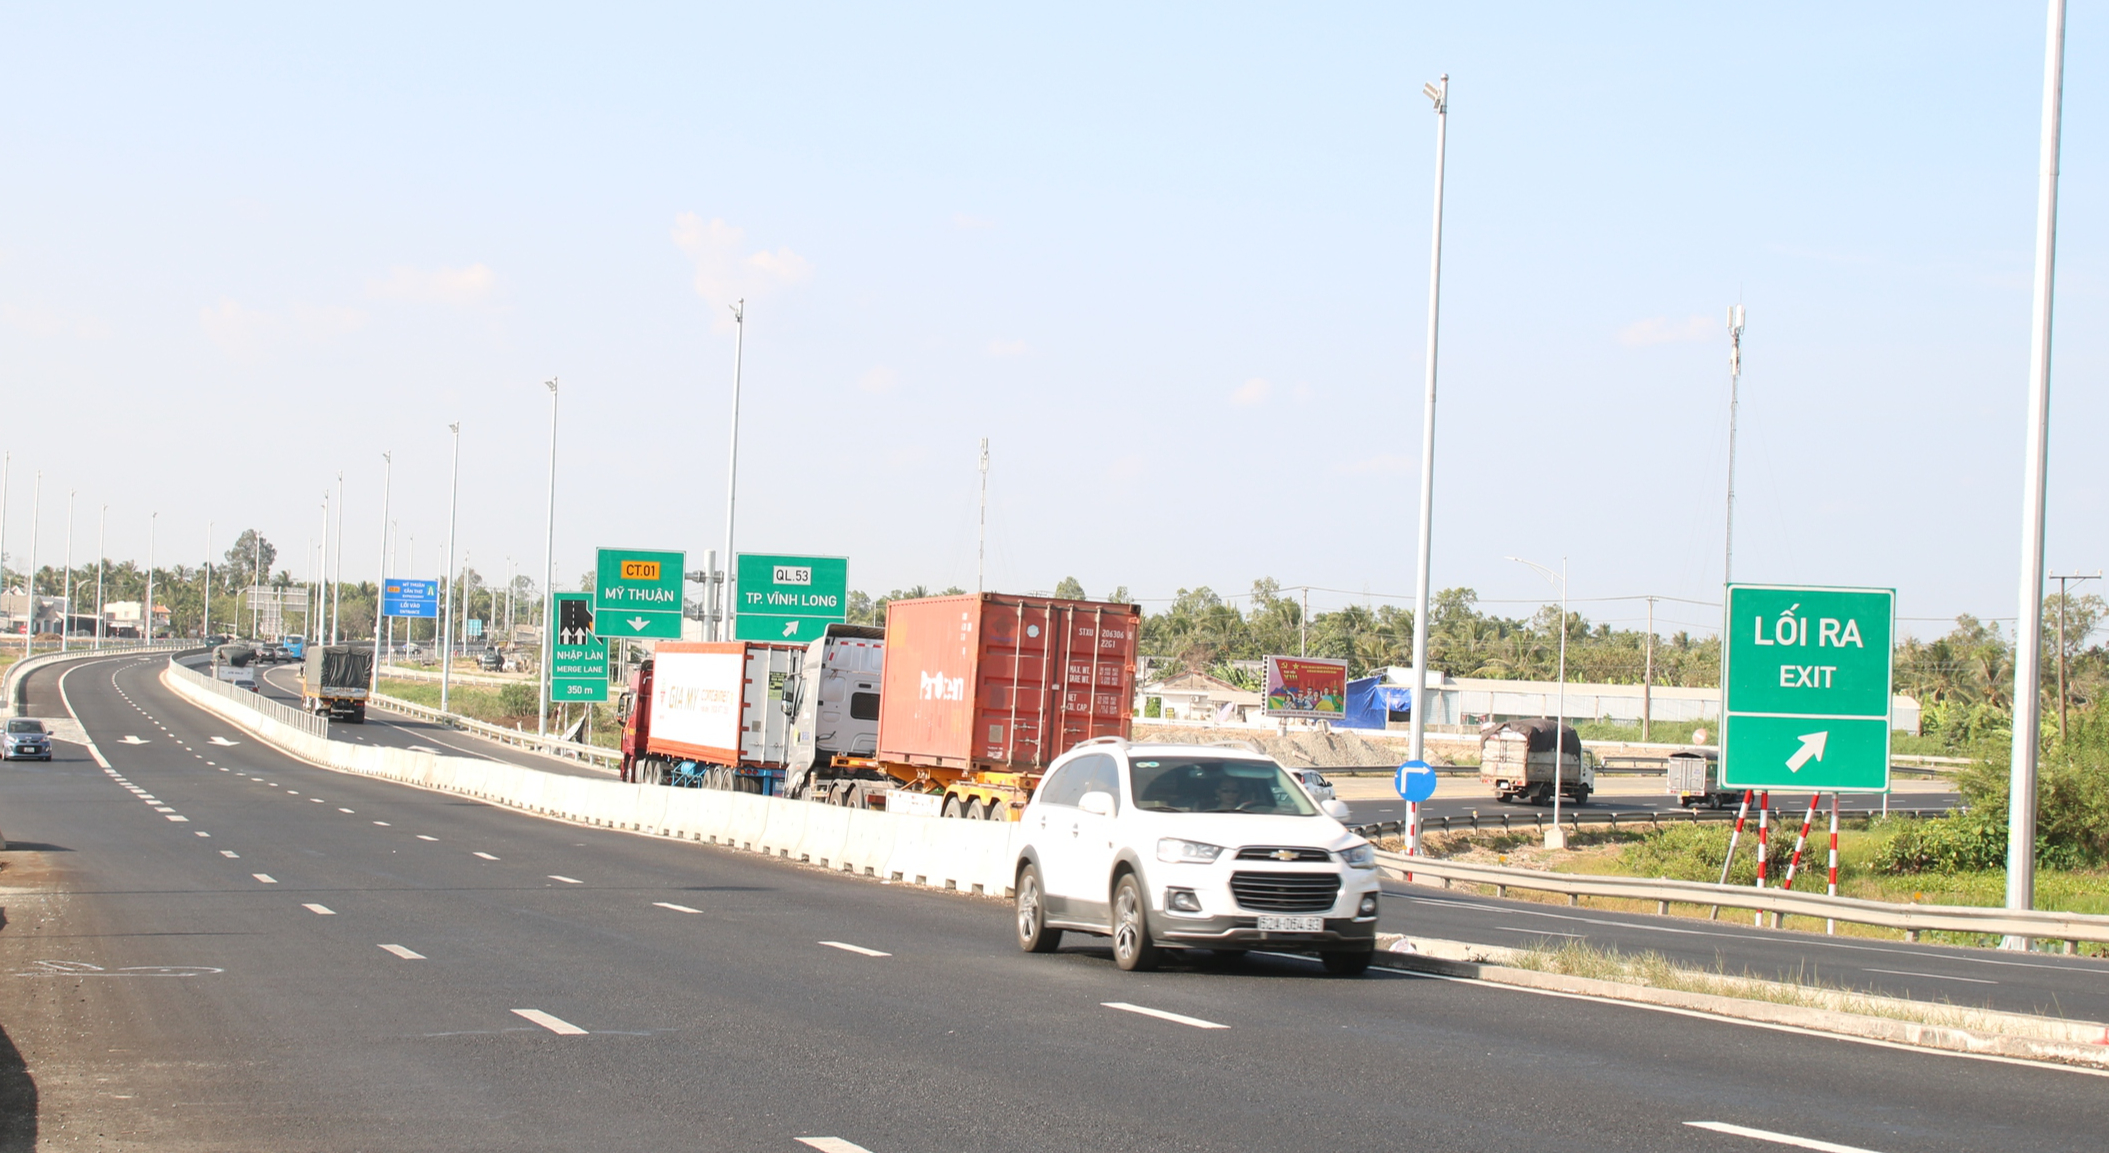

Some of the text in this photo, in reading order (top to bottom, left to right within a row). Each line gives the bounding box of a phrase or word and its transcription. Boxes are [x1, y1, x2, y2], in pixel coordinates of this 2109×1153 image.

[626, 564, 655, 577] CT.01
[776, 569, 808, 582] QL.53
[605, 586, 674, 603] MỸ THUẬN
[746, 591, 837, 607] TP. VĨNH LONG
[1754, 603, 1863, 649] LỐI RA
[1078, 628, 1094, 637] STXU
[1102, 629, 1125, 638] 206306
[1101, 639, 1116, 648] 22G1
[556, 649, 603, 662] NHẬP LÀN
[556, 665, 603, 673] MERGE LANE
[1780, 664, 1837, 689] EXIT
[567, 685, 582, 694] 350
[669, 686, 684, 709] GIA
[1077, 703, 1087, 711] CAP
